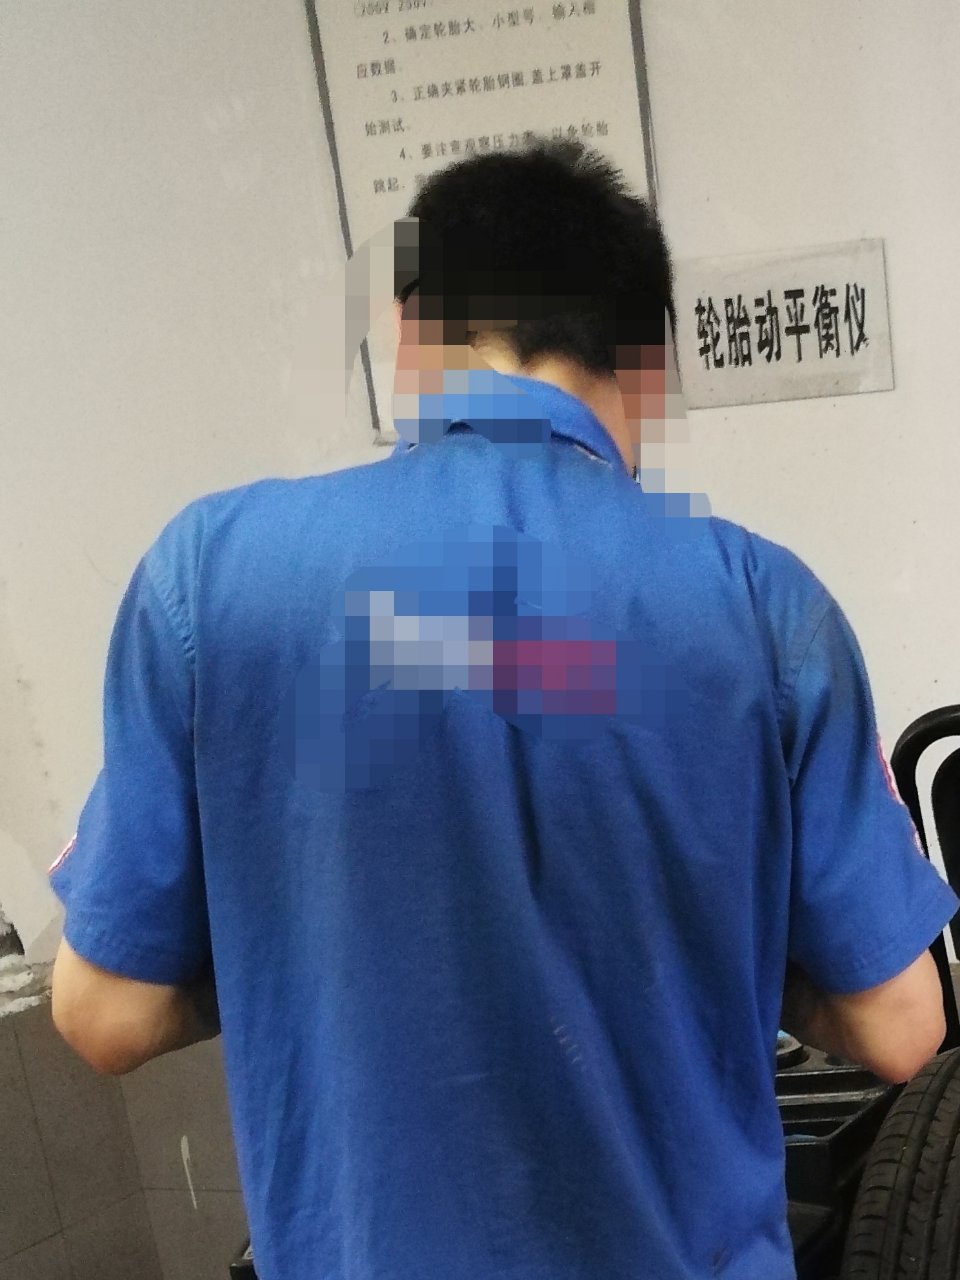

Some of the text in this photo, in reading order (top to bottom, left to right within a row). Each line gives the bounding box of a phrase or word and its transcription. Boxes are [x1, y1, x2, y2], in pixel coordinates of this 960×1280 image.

[695, 282, 868, 371] 轮胎动平衡仪
